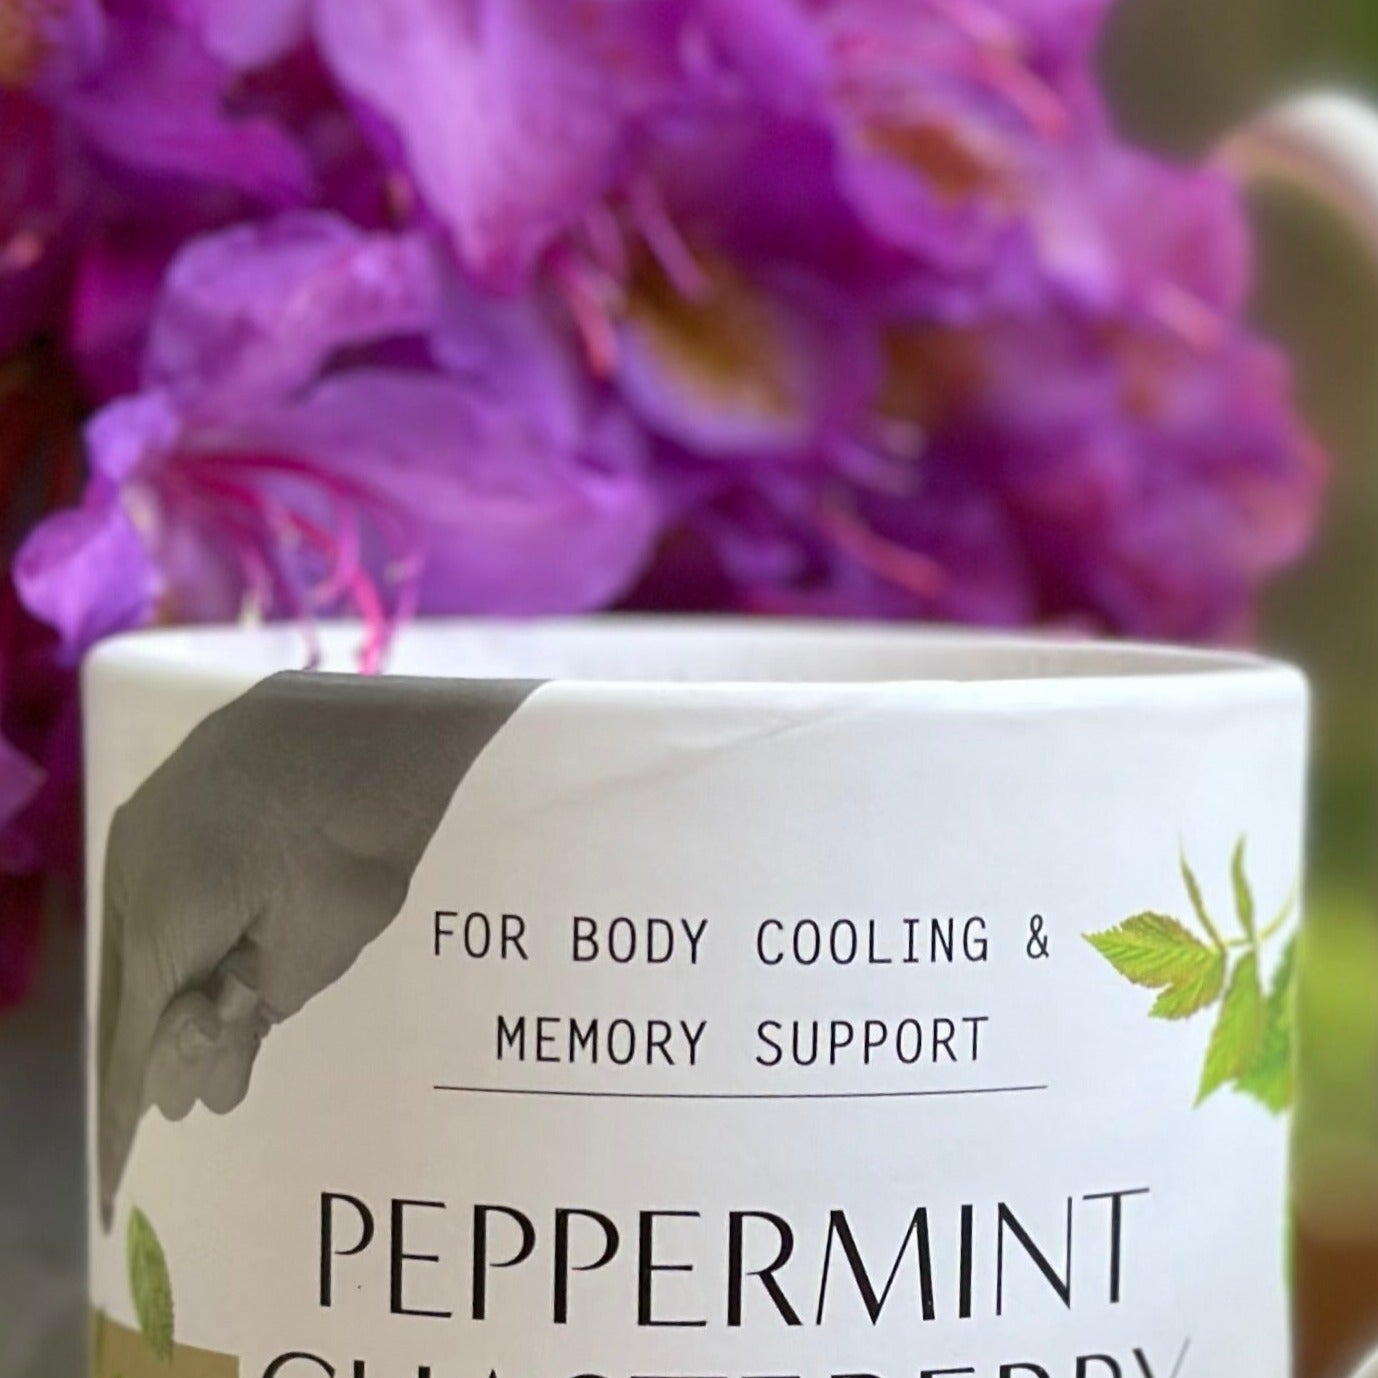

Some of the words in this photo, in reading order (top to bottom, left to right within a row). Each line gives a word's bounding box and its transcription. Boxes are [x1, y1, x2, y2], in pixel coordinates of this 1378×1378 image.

[433, 910, 529, 961] FOR
[571, 915, 709, 966] BODY
[756, 915, 988, 966] COOLING
[1025, 912, 1051, 960] &
[495, 1014, 708, 1067] MEMORY
[755, 1015, 990, 1067] SUPPORT
[318, 1186, 1152, 1328] PEPPERMINT
